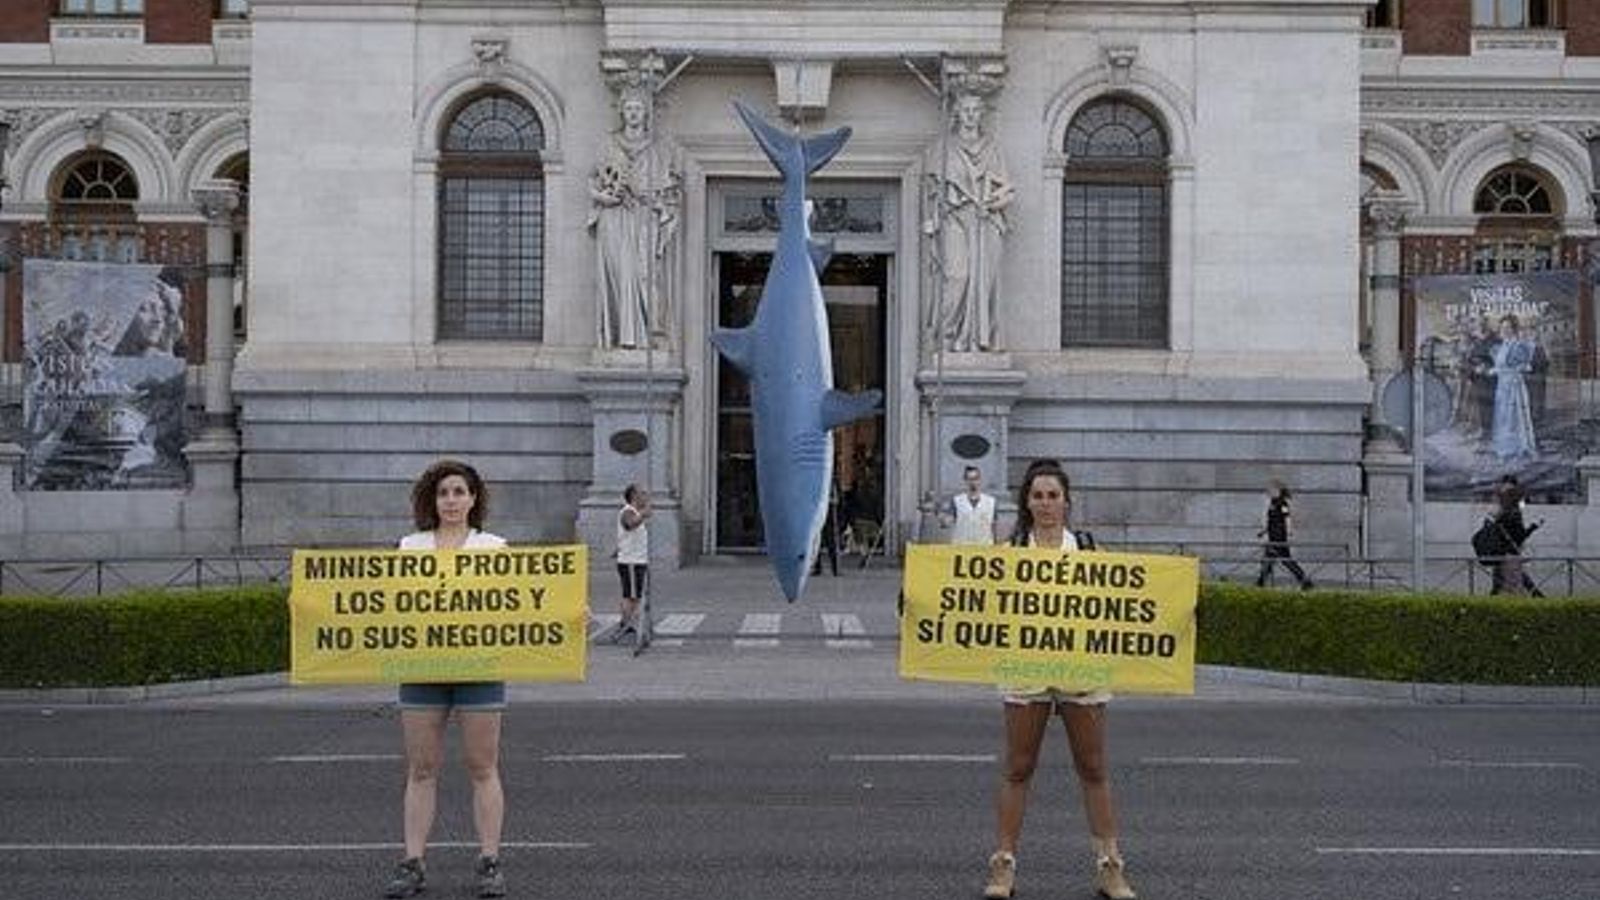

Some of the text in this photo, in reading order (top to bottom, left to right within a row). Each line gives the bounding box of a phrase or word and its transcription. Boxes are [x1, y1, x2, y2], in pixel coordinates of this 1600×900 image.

[305, 552, 575, 579] MINISTRO, PROTEGE
[954, 555, 1146, 589] LOS OCÉANOS
[336, 583, 544, 614] LOS OCÉANOS Y
[939, 587, 1156, 623] SIN TIBURONES
[317, 622, 563, 650] NO SUS NEGOCIOS
[917, 613, 1176, 657] SÍ QUE DAN MIEDO
